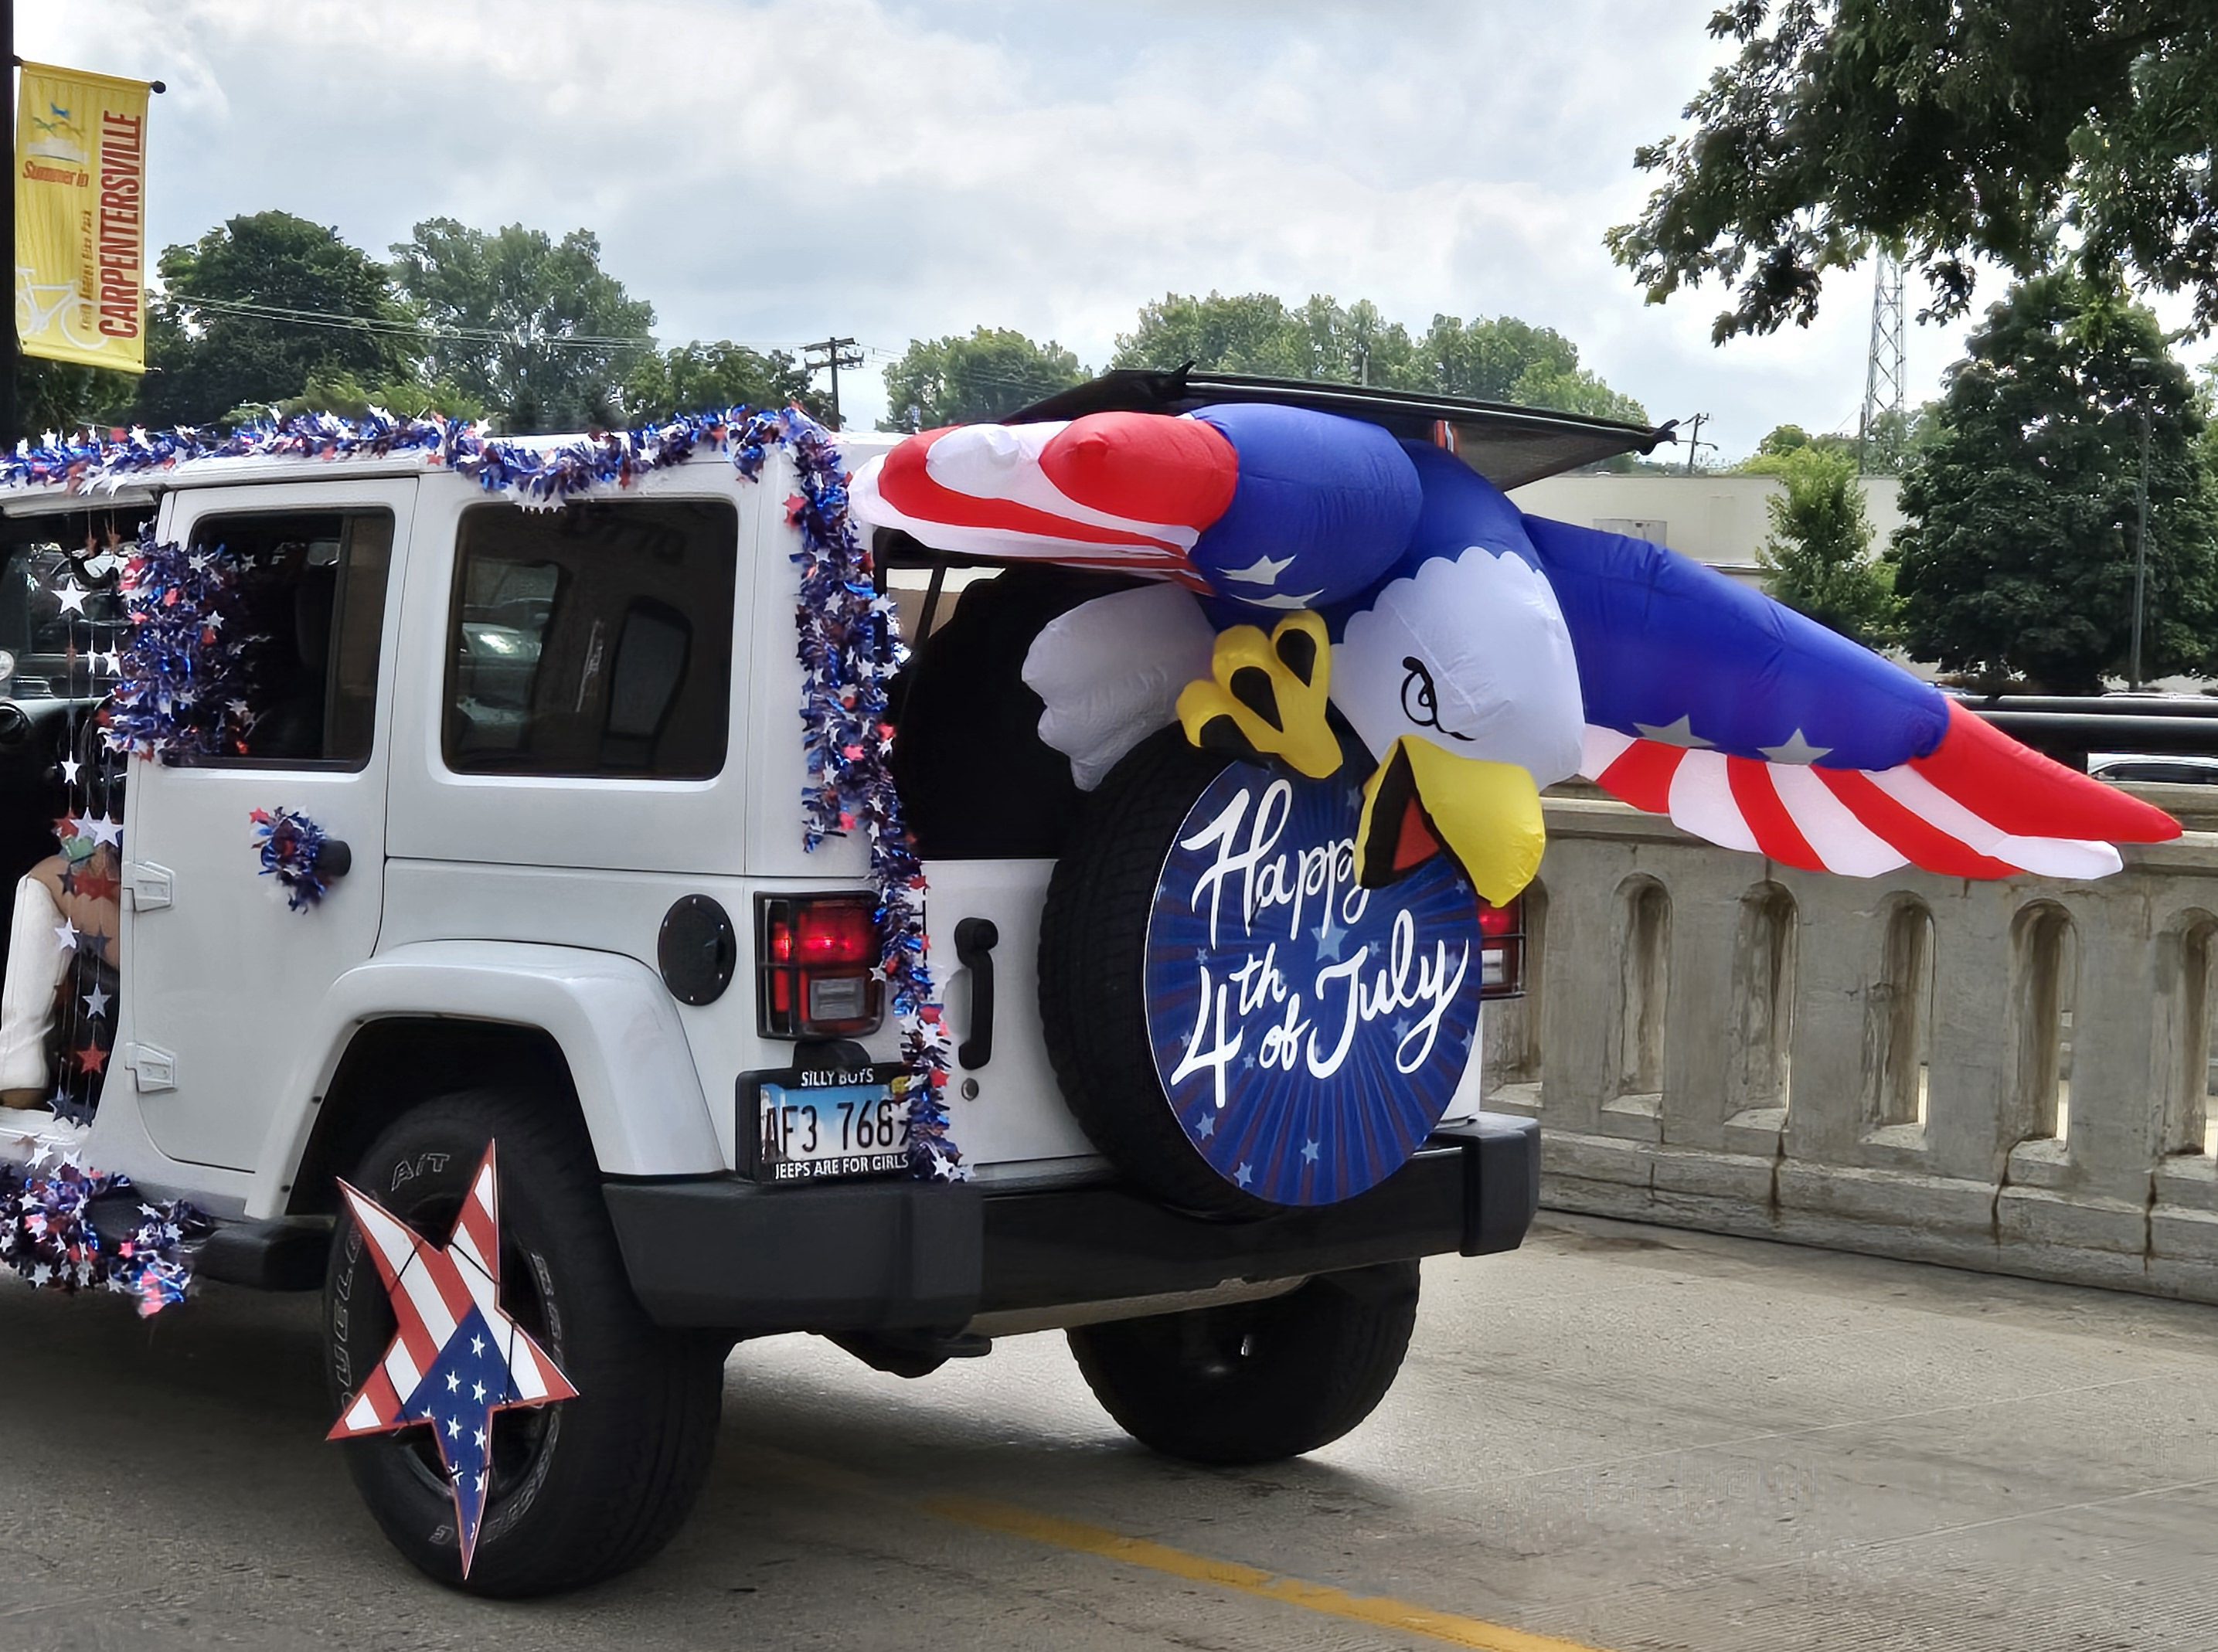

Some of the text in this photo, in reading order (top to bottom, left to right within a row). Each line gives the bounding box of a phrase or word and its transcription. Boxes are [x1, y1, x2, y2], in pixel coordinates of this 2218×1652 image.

[22, 160, 77, 185] Summer
[99, 110, 142, 339] CARPENTERSVILLE
[1258, 908, 1469, 1079] of July
[1171, 942, 1287, 1109] 4th
[801, 1070, 835, 1087] SILLY
[763, 1104, 818, 1161] AF3
[390, 1152, 451, 1192] A/T
[775, 1153, 909, 1180] JEEPS ARE FOR GIRLS
